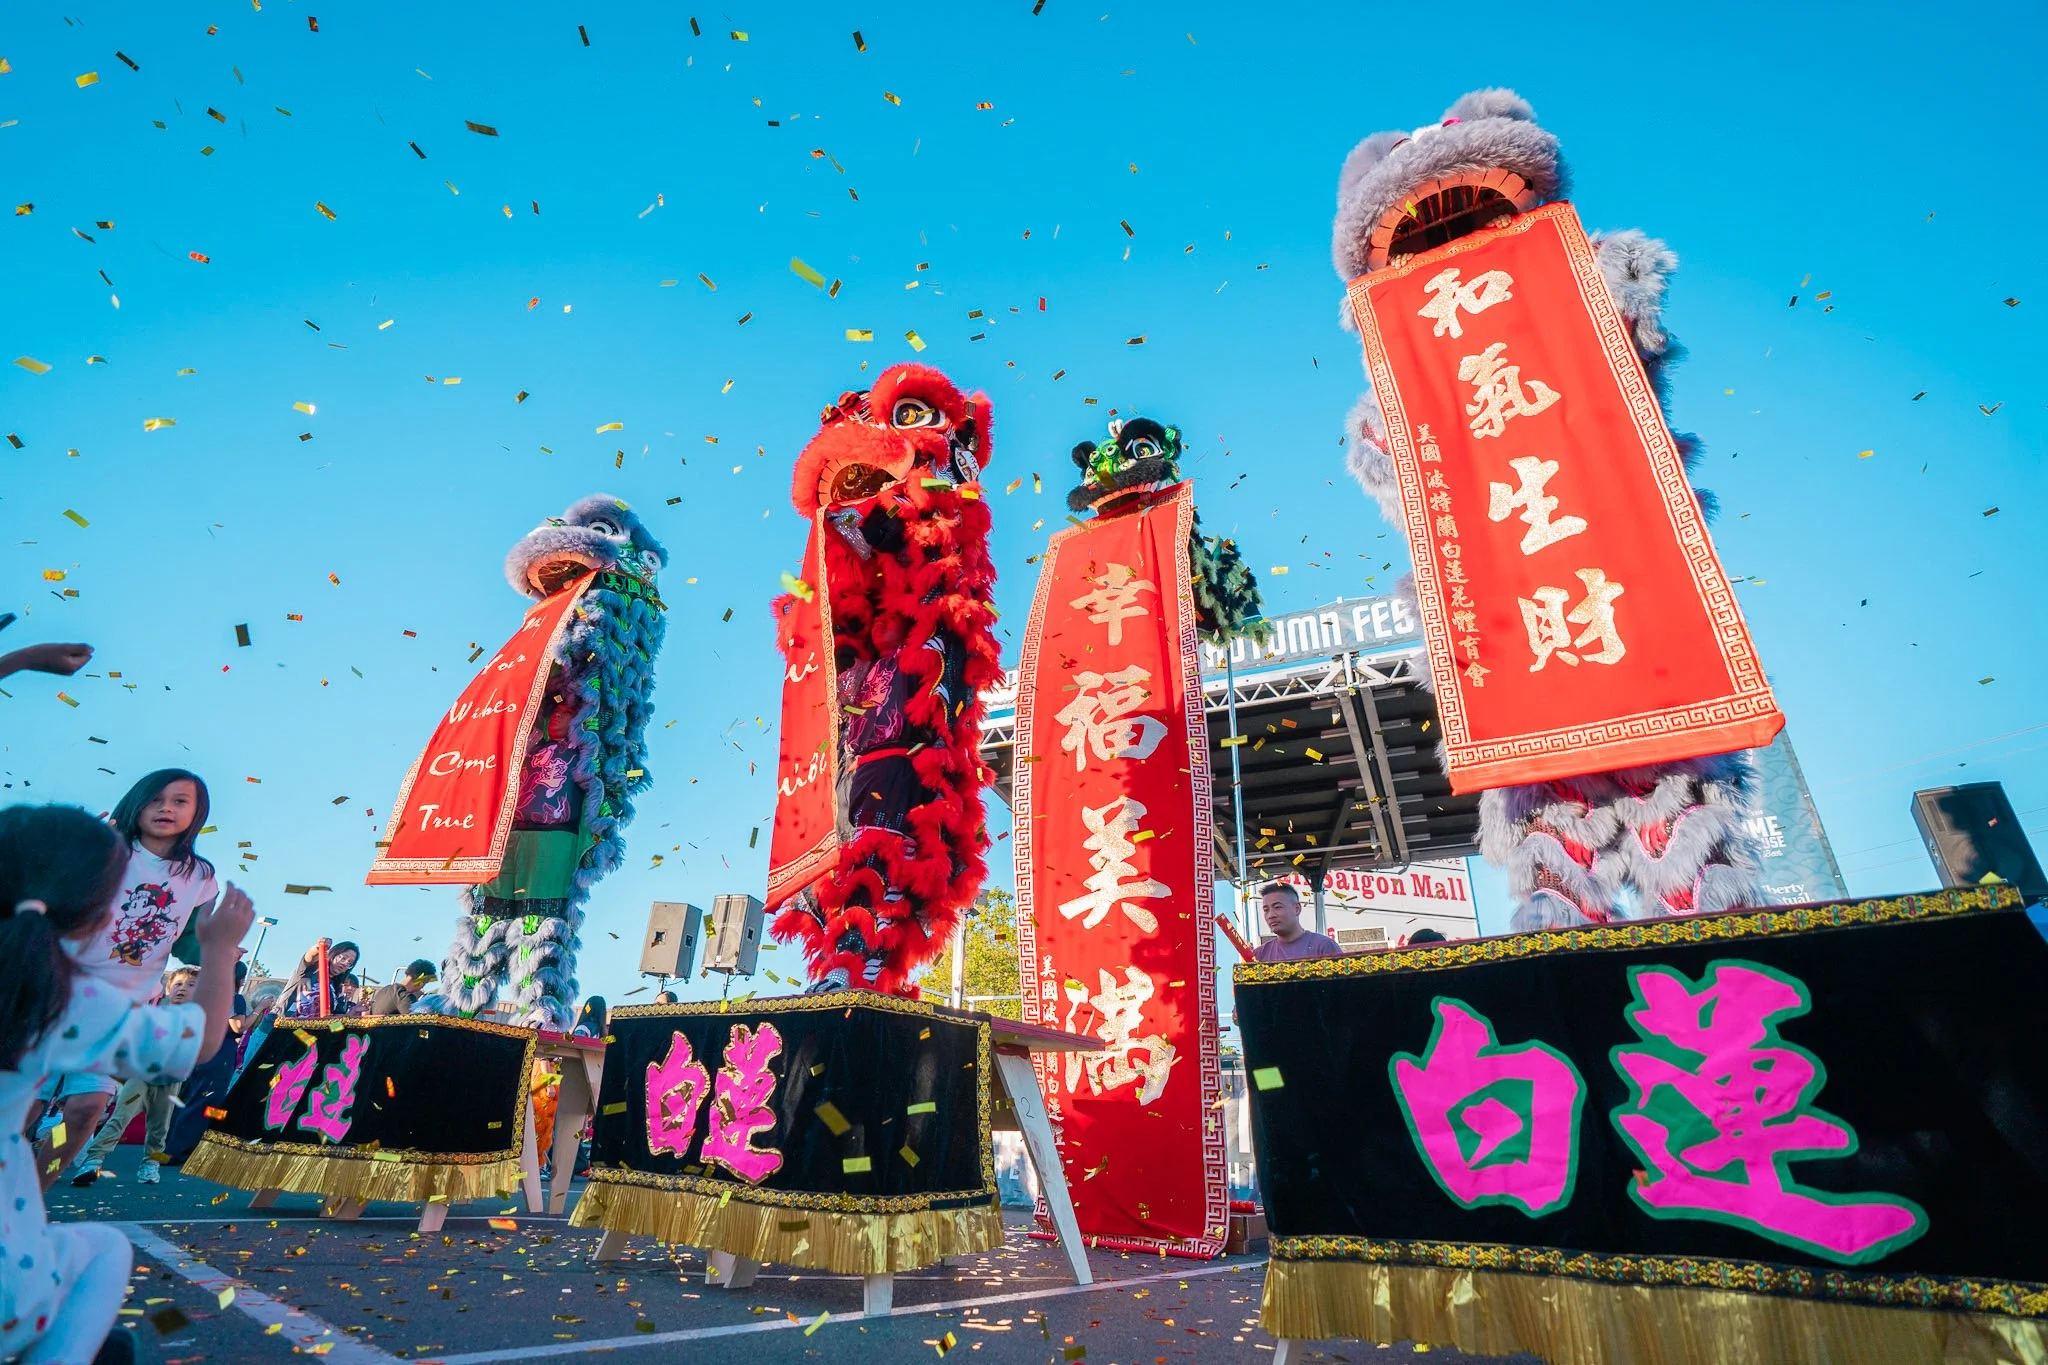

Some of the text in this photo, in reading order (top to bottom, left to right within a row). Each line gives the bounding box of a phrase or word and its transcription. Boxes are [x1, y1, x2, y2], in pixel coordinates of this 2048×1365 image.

[1416, 267, 1626, 672] 和氣生財
[429, 750, 497, 776] Come
[419, 804, 475, 831] True
[1410, 873, 1467, 901] Mall
[645, 1021, 784, 1185] 白蓮
[1389, 958, 1930, 1266] 白蓮
